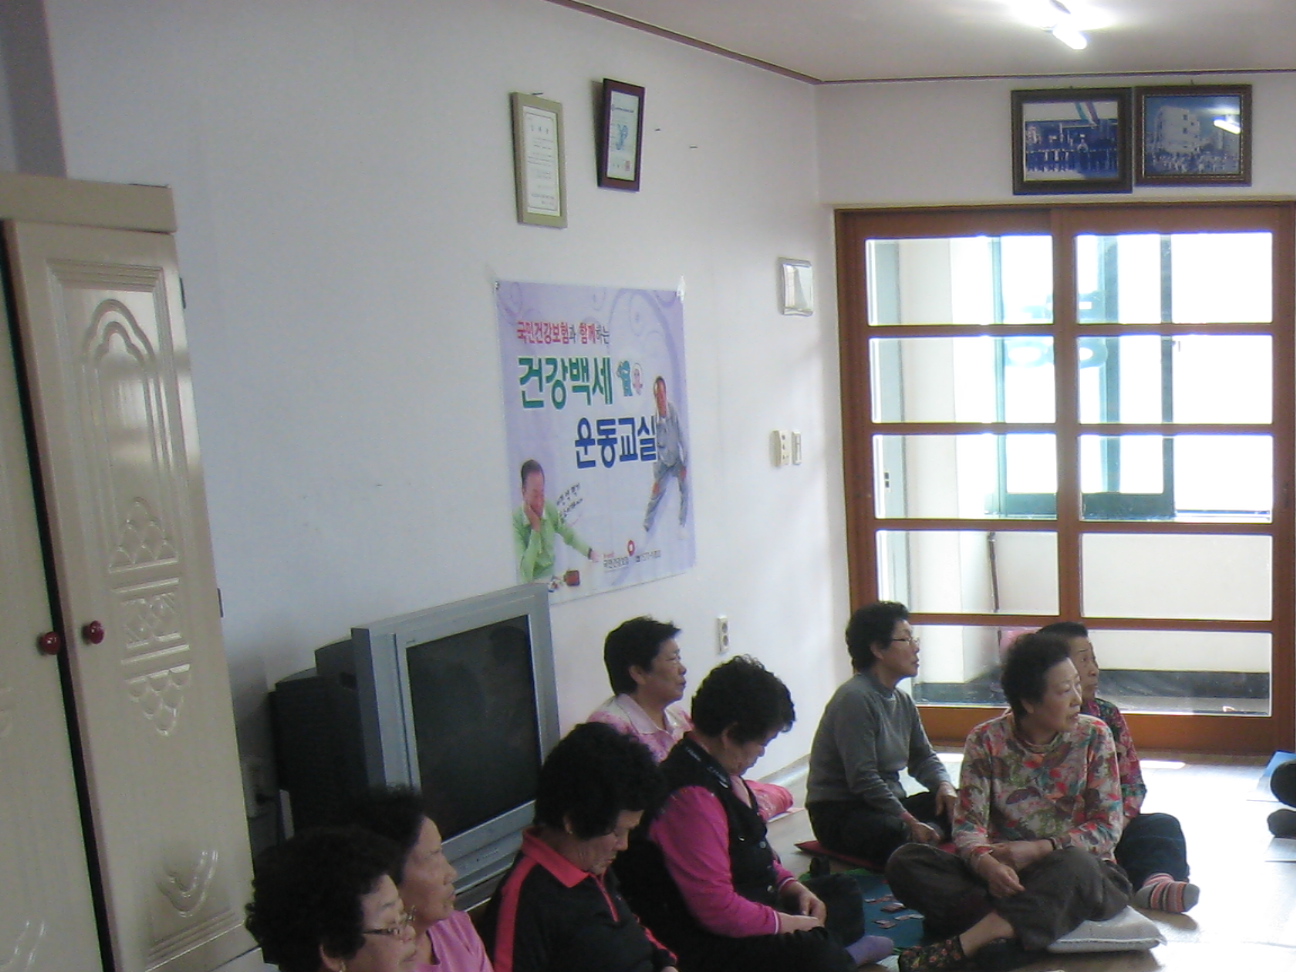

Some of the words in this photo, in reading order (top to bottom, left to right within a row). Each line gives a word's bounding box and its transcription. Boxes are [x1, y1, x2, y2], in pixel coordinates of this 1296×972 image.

[517, 321, 576, 344] 국민건강보험과
[579, 321, 610, 345] 함께하는
[518, 357, 613, 410] 건강백세
[574, 415, 657, 469] 운동교실
